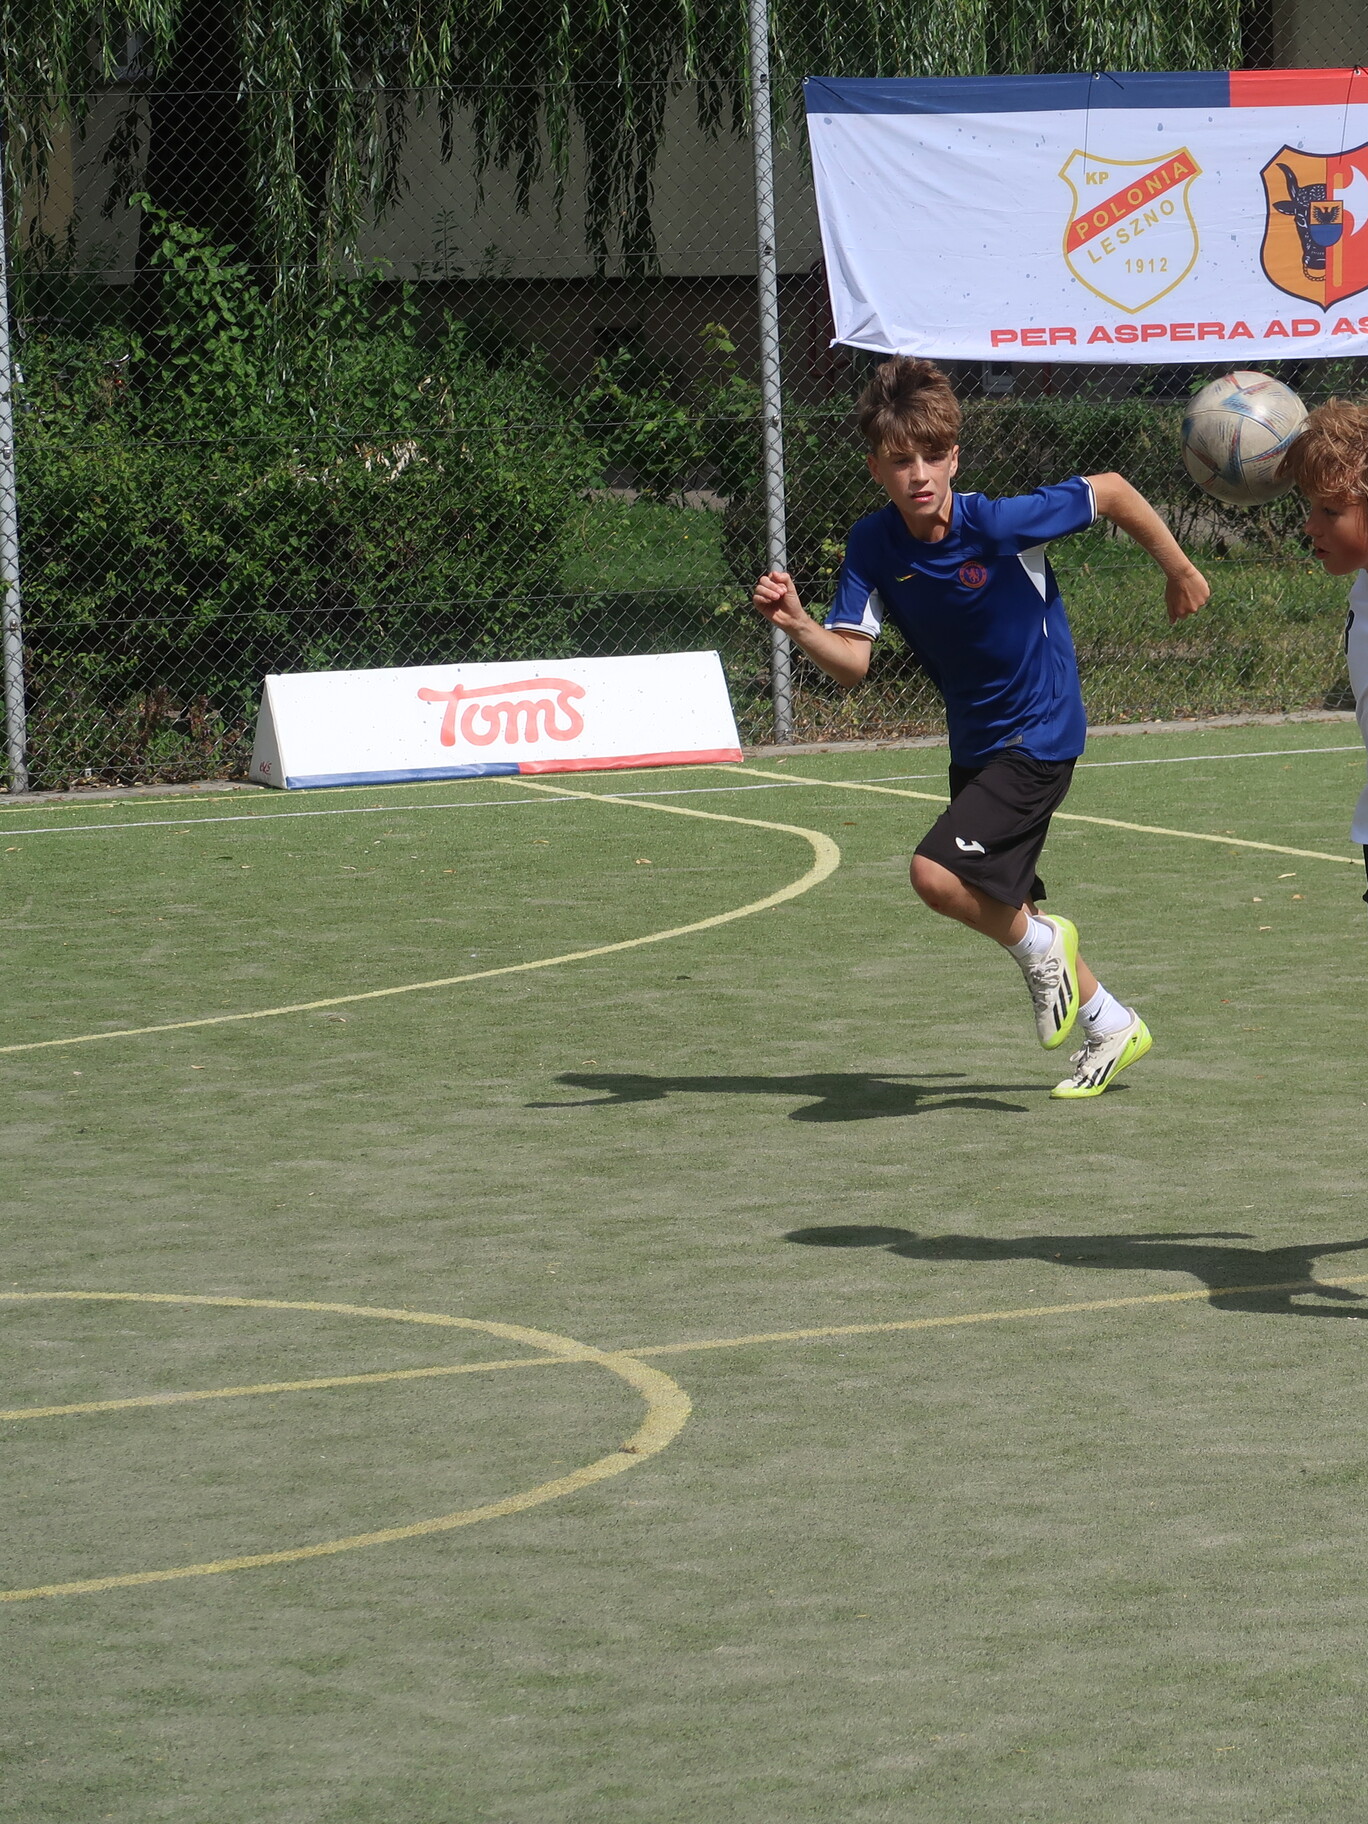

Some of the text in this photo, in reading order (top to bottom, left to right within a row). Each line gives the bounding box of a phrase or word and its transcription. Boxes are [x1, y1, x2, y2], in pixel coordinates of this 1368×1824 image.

[1075, 161, 1189, 240] POLONIA
[1085, 171, 1109, 185] KP
[1087, 199, 1175, 264] LESZNO
[1125, 257, 1168, 273] 1912
[990, 326, 1077, 348] PER
[1087, 321, 1255, 344] ASPERA
[1263, 318, 1321, 339] AD
[417, 677, 586, 747] Toms
